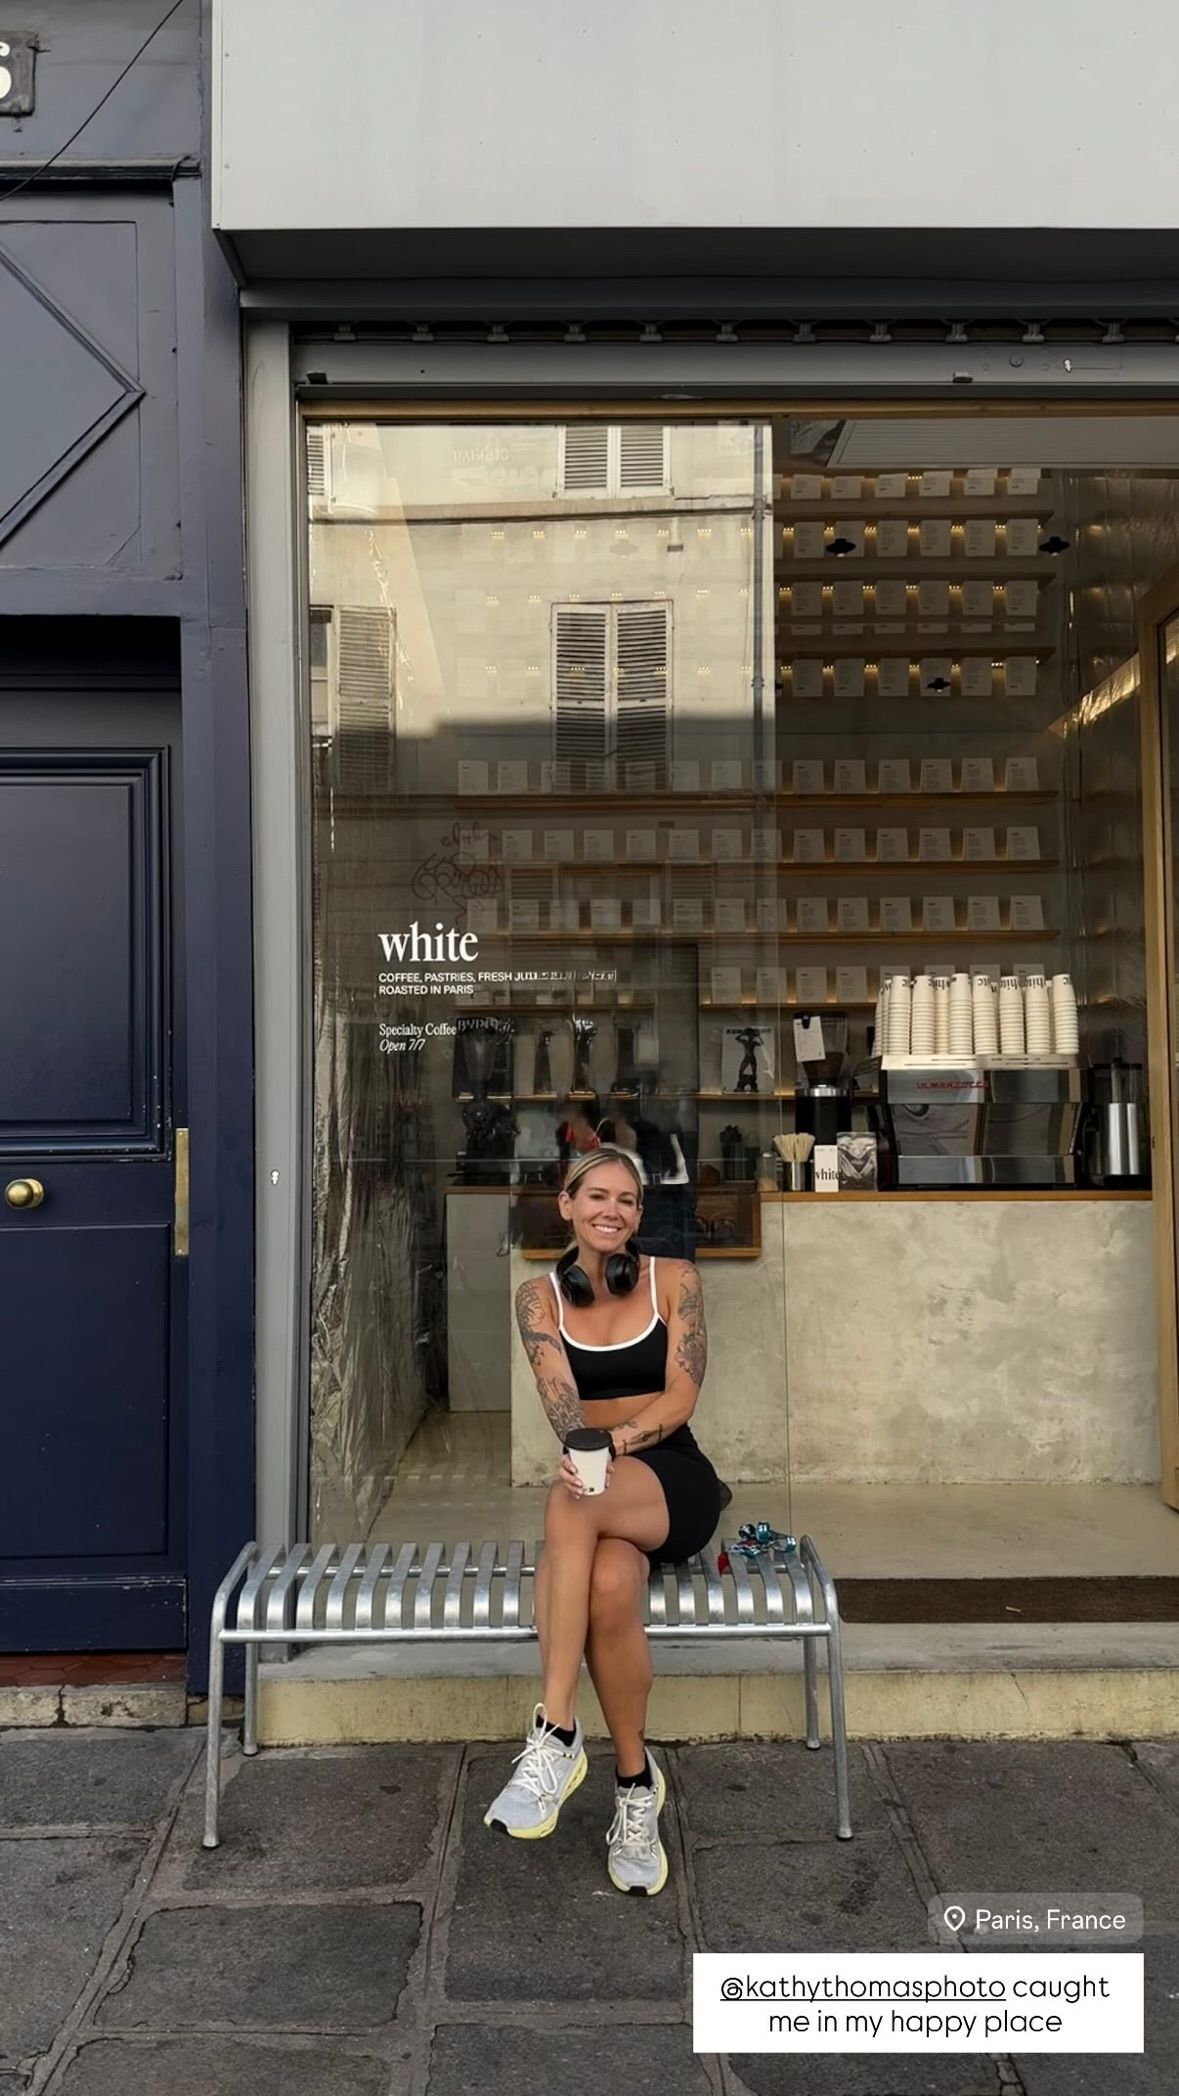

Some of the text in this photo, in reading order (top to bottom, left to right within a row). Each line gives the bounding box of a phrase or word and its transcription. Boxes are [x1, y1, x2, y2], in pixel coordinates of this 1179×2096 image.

[378, 922, 478, 961] white
[379, 973, 422, 983] COFFEE,
[425, 972, 476, 982] PASTRIES,
[478, 972, 512, 982] FRESH
[380, 985, 474, 995] ROASTED IN PARIS
[380, 1023, 423, 1038] Specialty
[425, 1023, 456, 1035] Coffee
[380, 1038, 425, 1054] Open 7/7
